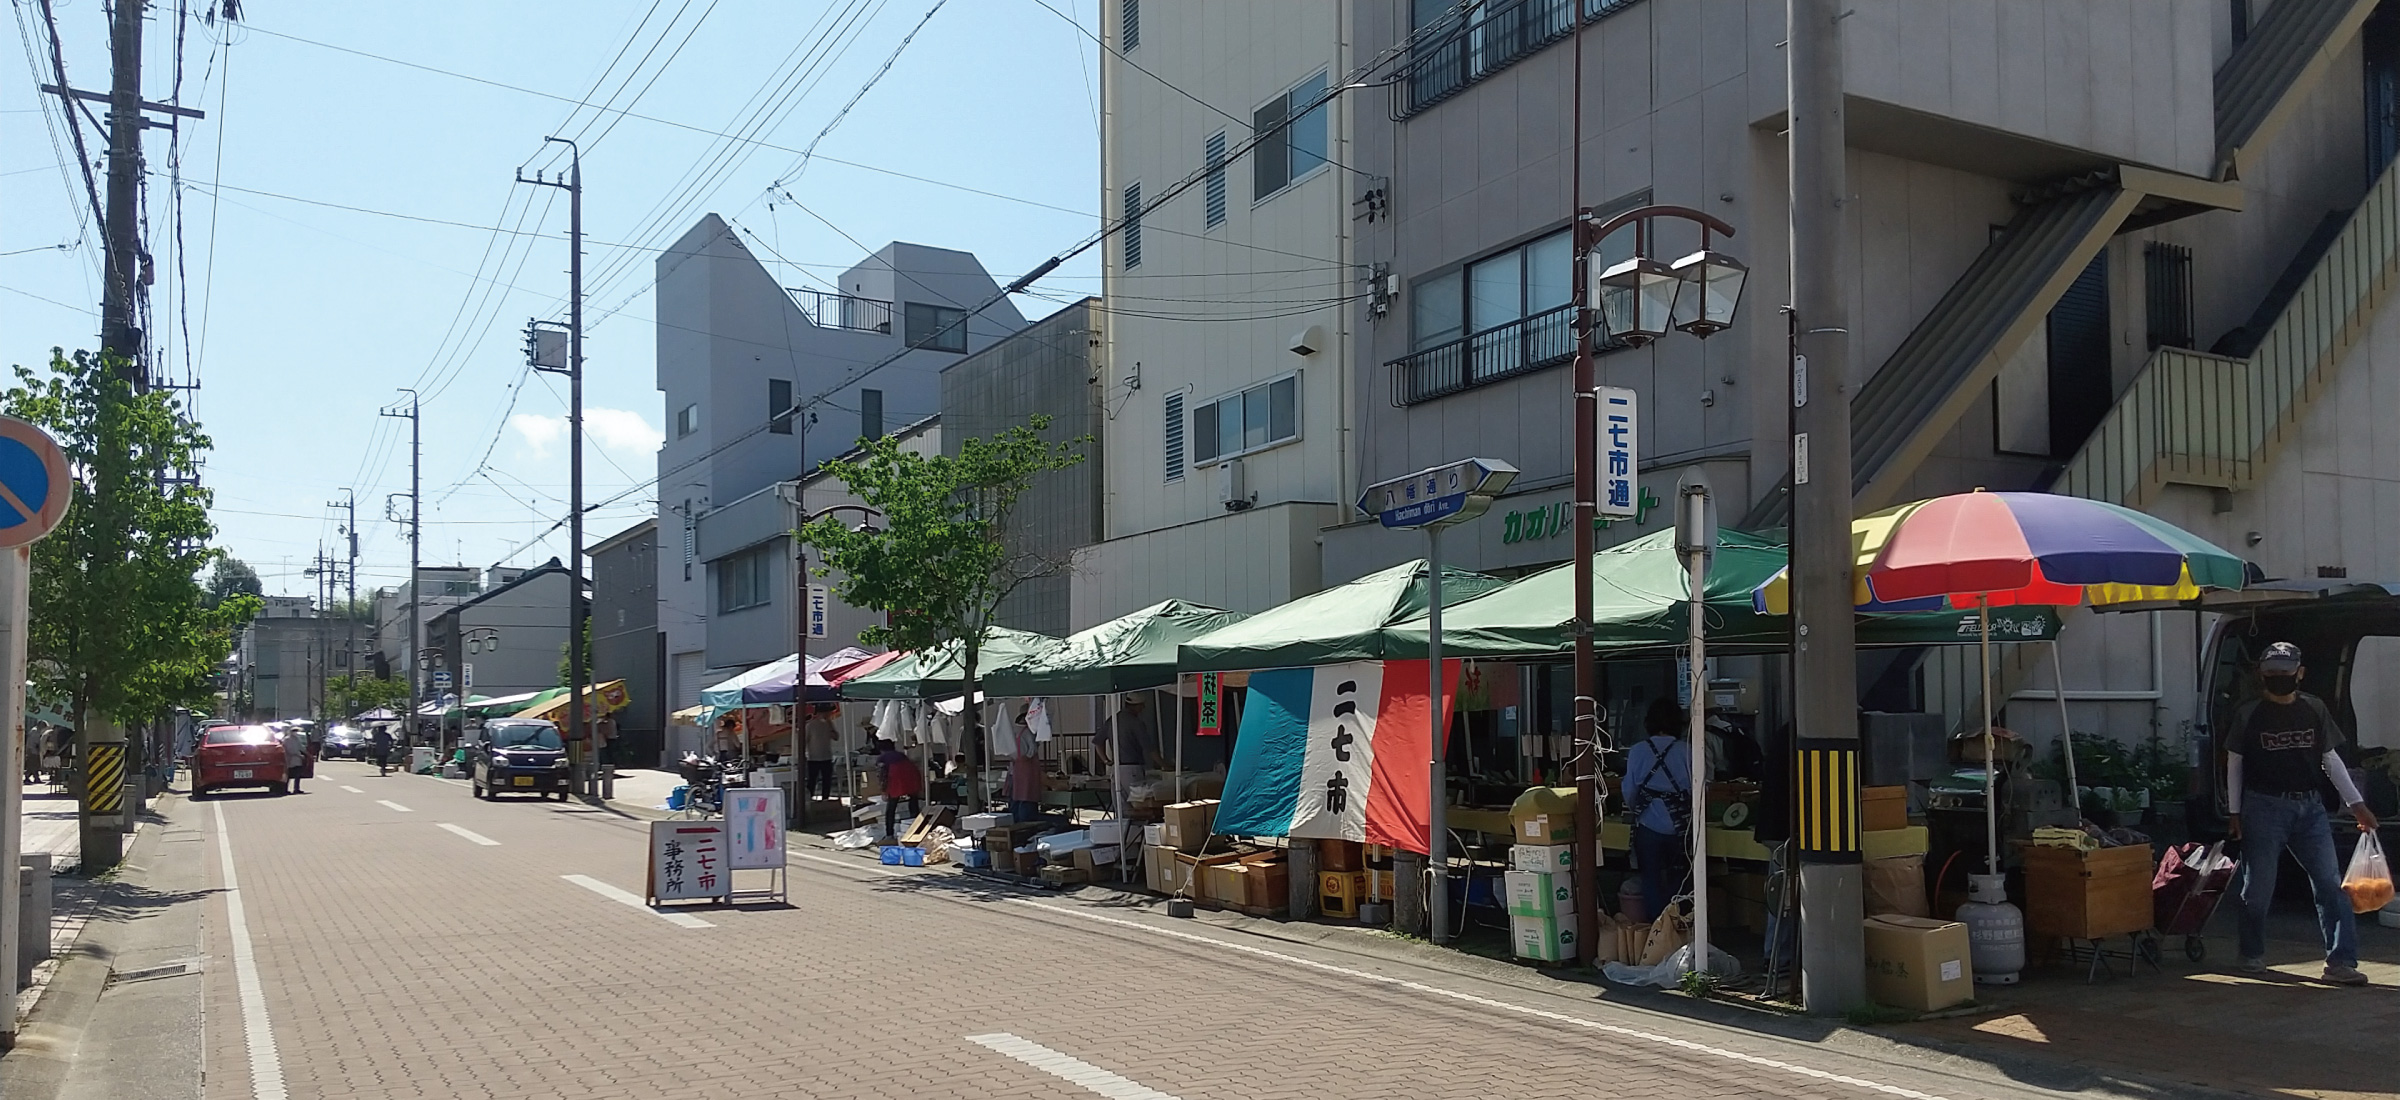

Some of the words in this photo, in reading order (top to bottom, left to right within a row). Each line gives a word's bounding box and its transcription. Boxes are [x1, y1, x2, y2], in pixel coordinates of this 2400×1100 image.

[1607, 398, 1630, 507] 二七市通
[1385, 472, 1458, 507] 八幡通り
[1394, 506, 1422, 522] Hachiman
[1438, 501, 1450, 511] Ave.
[812, 588, 824, 636] 二七市通
[1326, 680, 1357, 815] 二七市
[663, 839, 685, 894] 事務所
[696, 838, 717, 892] 二七市
